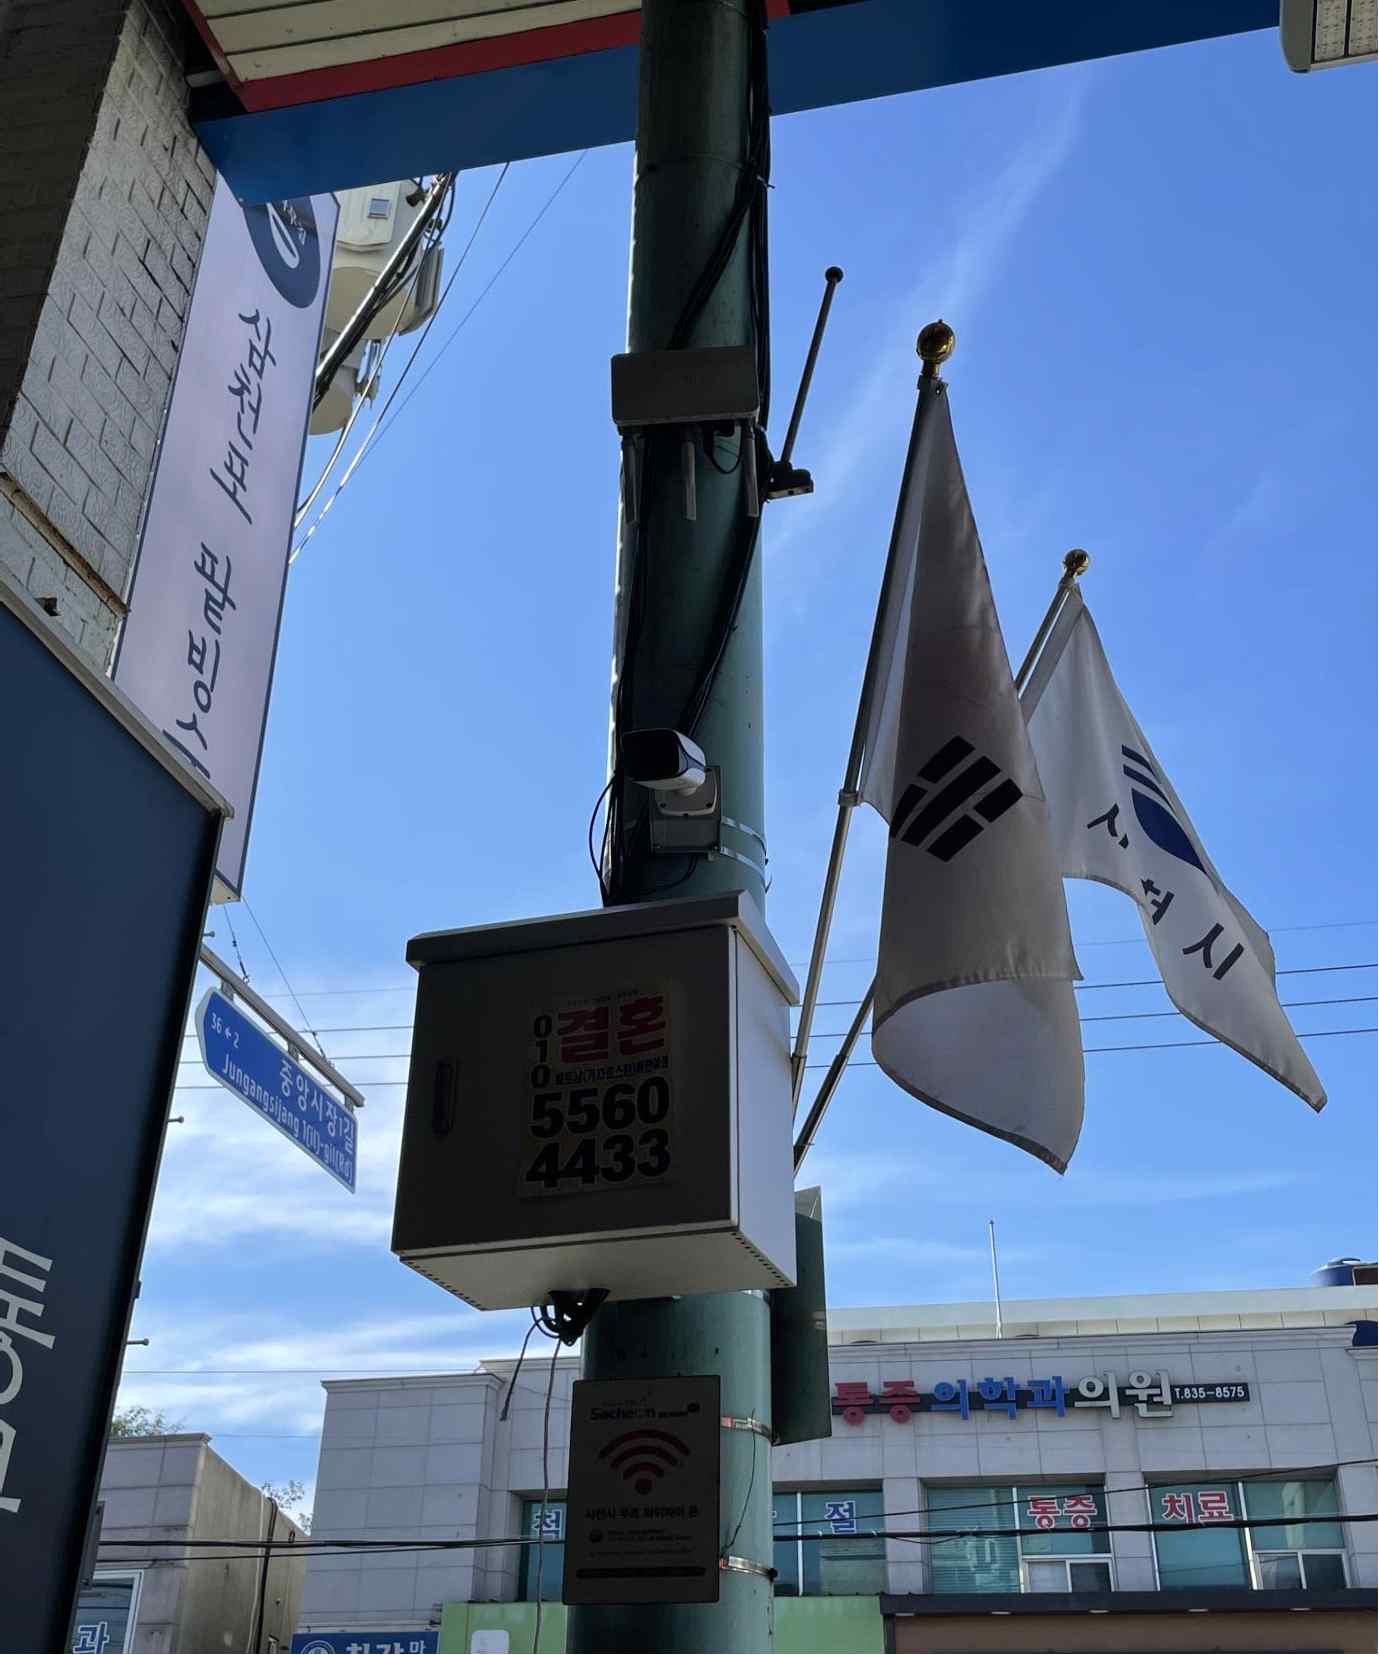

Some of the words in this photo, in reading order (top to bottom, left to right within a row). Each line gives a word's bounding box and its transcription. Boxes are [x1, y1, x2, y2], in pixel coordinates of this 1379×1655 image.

[209, 307, 277, 525] 삼천포
[210, 1012, 223, 1034] 36
[232, 1031, 241, 1049] 2
[221, 1054, 300, 1136] Jungangsijang
[279, 1059, 355, 1154] 중앙시장1길
[528, 1076, 670, 1138] 5560
[525, 1128, 672, 1188] 4433
[833, 1380, 921, 1426] 통증
[929, 1375, 1070, 1421] 의학과
[1074, 1369, 1174, 1419] 의원
[1174, 1386, 1245, 1400] T.835-8575
[1027, 1495, 1098, 1530] 통증
[1162, 1490, 1234, 1525] 치료
